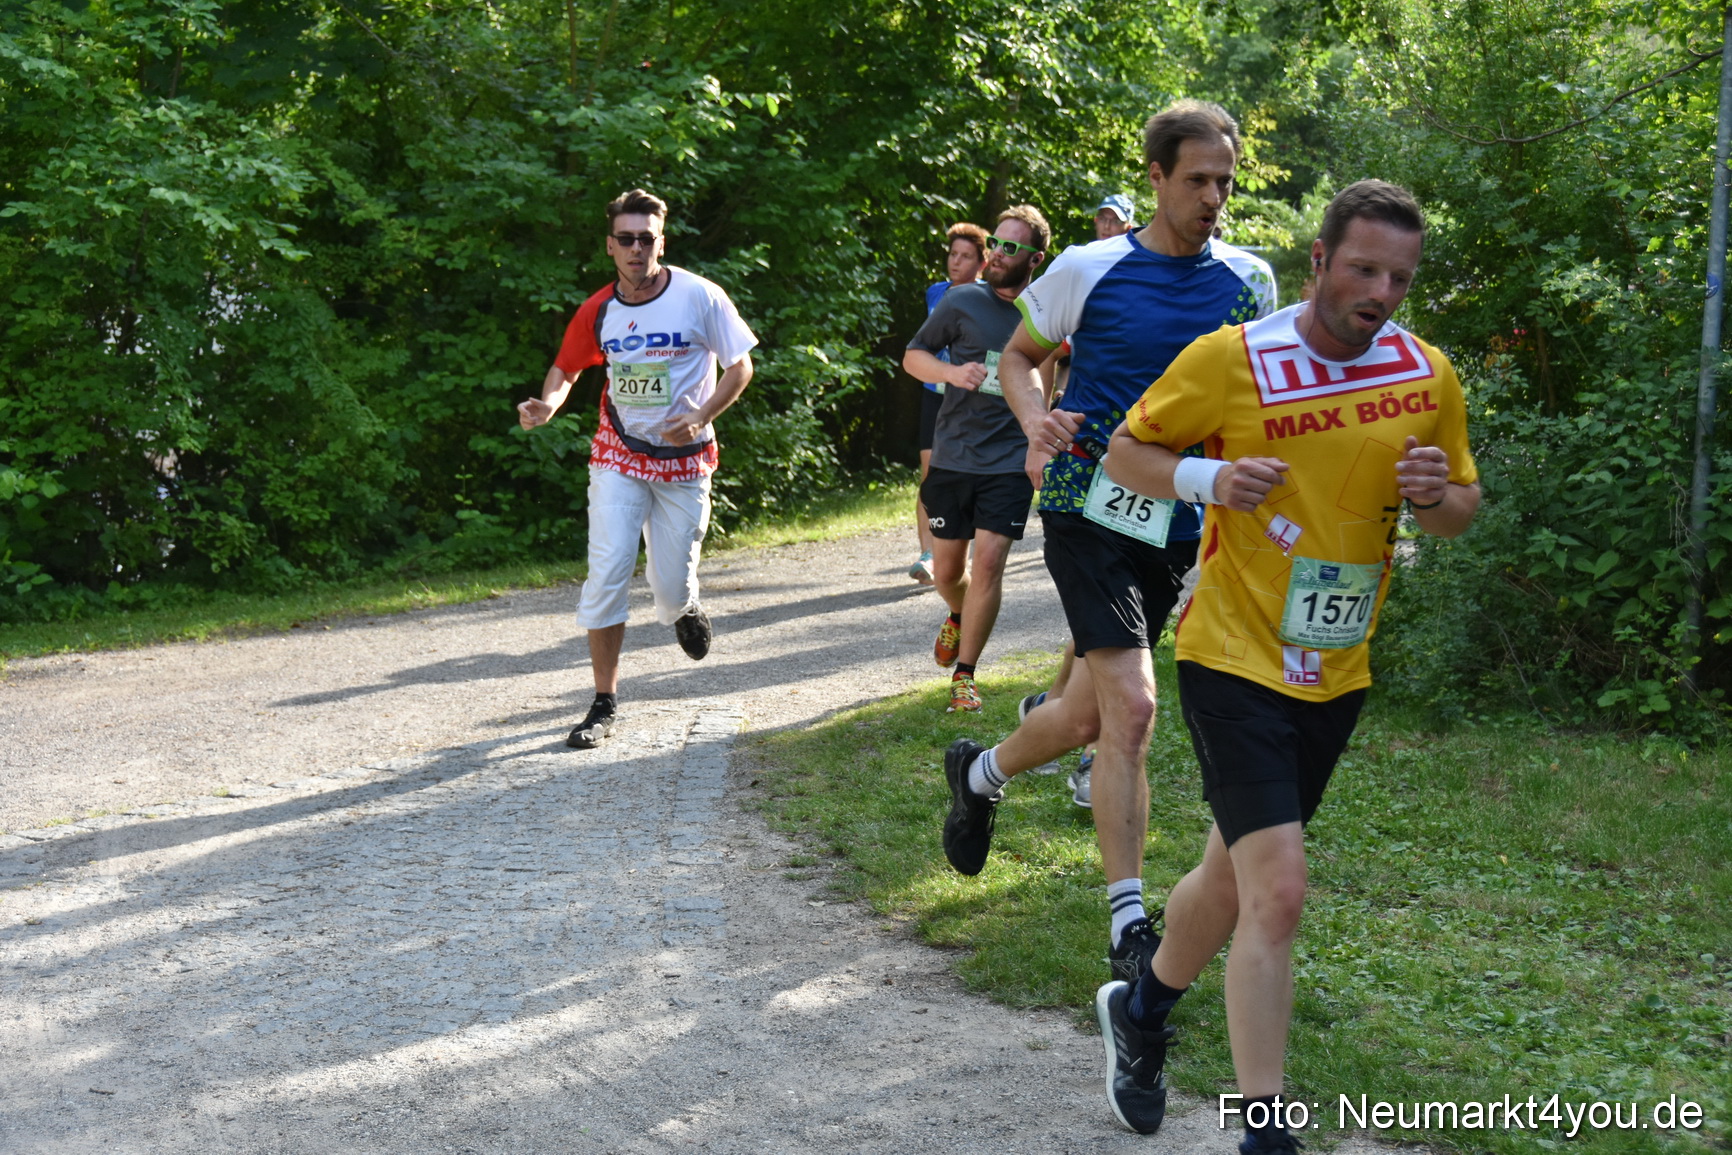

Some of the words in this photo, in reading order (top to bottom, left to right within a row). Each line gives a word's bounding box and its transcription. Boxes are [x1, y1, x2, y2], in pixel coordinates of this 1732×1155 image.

[618, 378, 662, 395] 2074
[1263, 407, 1346, 441] MAX
[1356, 390, 1438, 425] BÖGL
[602, 449, 641, 471] AVIA
[645, 458, 683, 472] AVIA
[1105, 486, 1154, 522] 215
[1104, 509, 1118, 520] Graf
[1118, 514, 1147, 530] Christian
[1302, 592, 1370, 625] 1570
[1306, 624, 1332, 634] Fuchs
